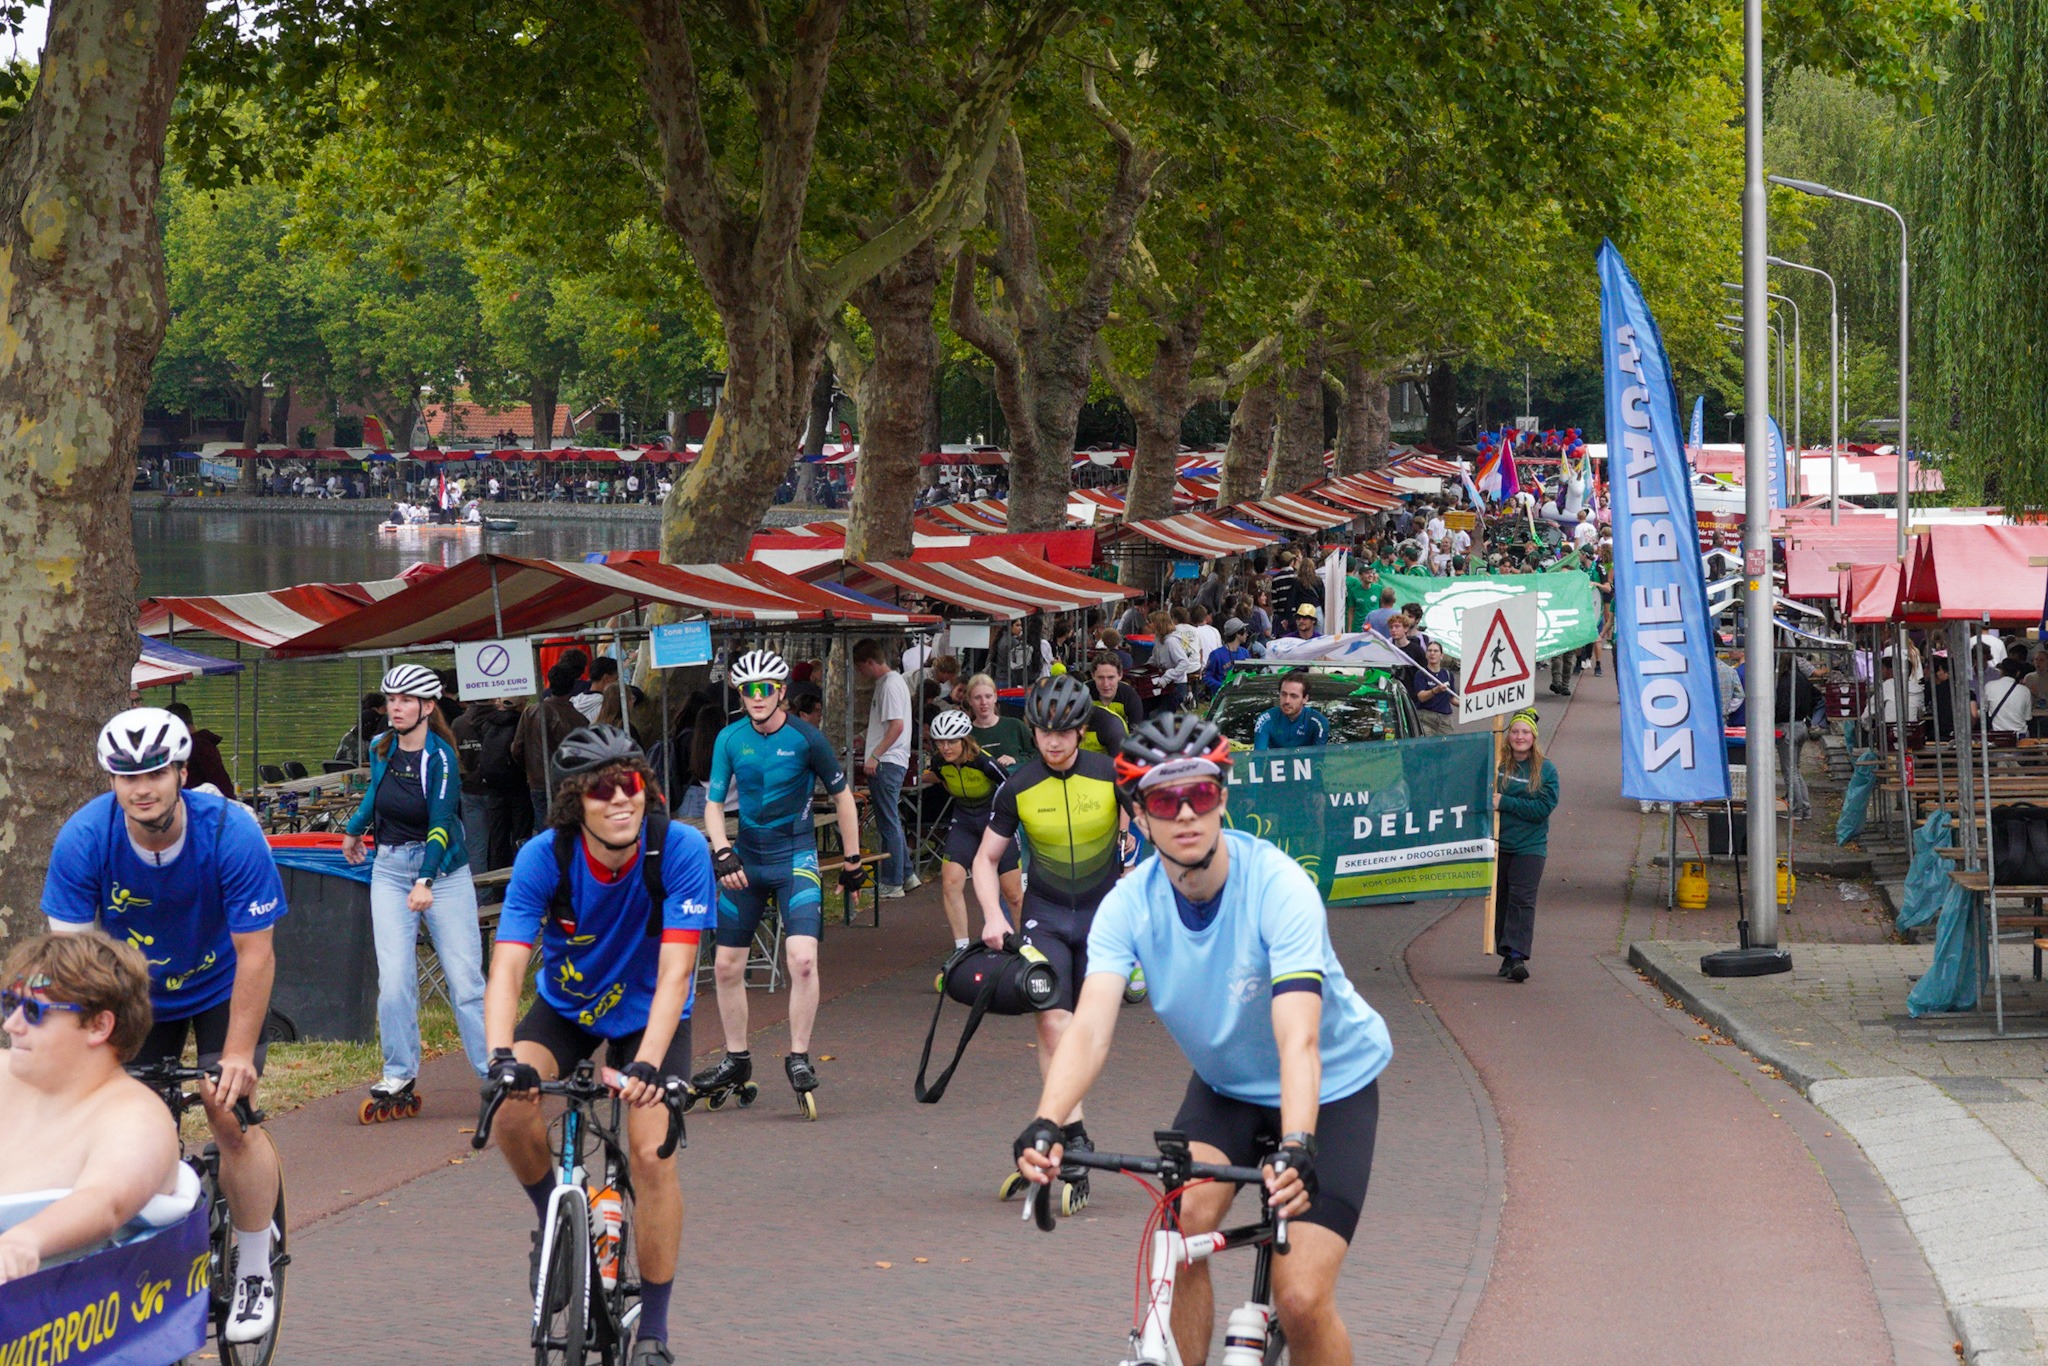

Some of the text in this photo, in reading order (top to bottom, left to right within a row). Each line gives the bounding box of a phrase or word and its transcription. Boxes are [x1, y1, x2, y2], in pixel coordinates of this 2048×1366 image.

[684, 626, 702, 634] Blue
[466, 677, 528, 690] BOETE 150 EURO
[1464, 684, 1526, 714] KLUNEN
[1227, 757, 1313, 786] LLEN
[1329, 790, 1370, 807] VAN
[1353, 804, 1468, 840] DELFT
[1344, 843, 1484, 868] SKEELEREN DROOGTRAINEN
[1362, 877, 1383, 888] KOM
[1384, 874, 1417, 886] GRATIS
[1031, 979, 1051, 993] JBL
